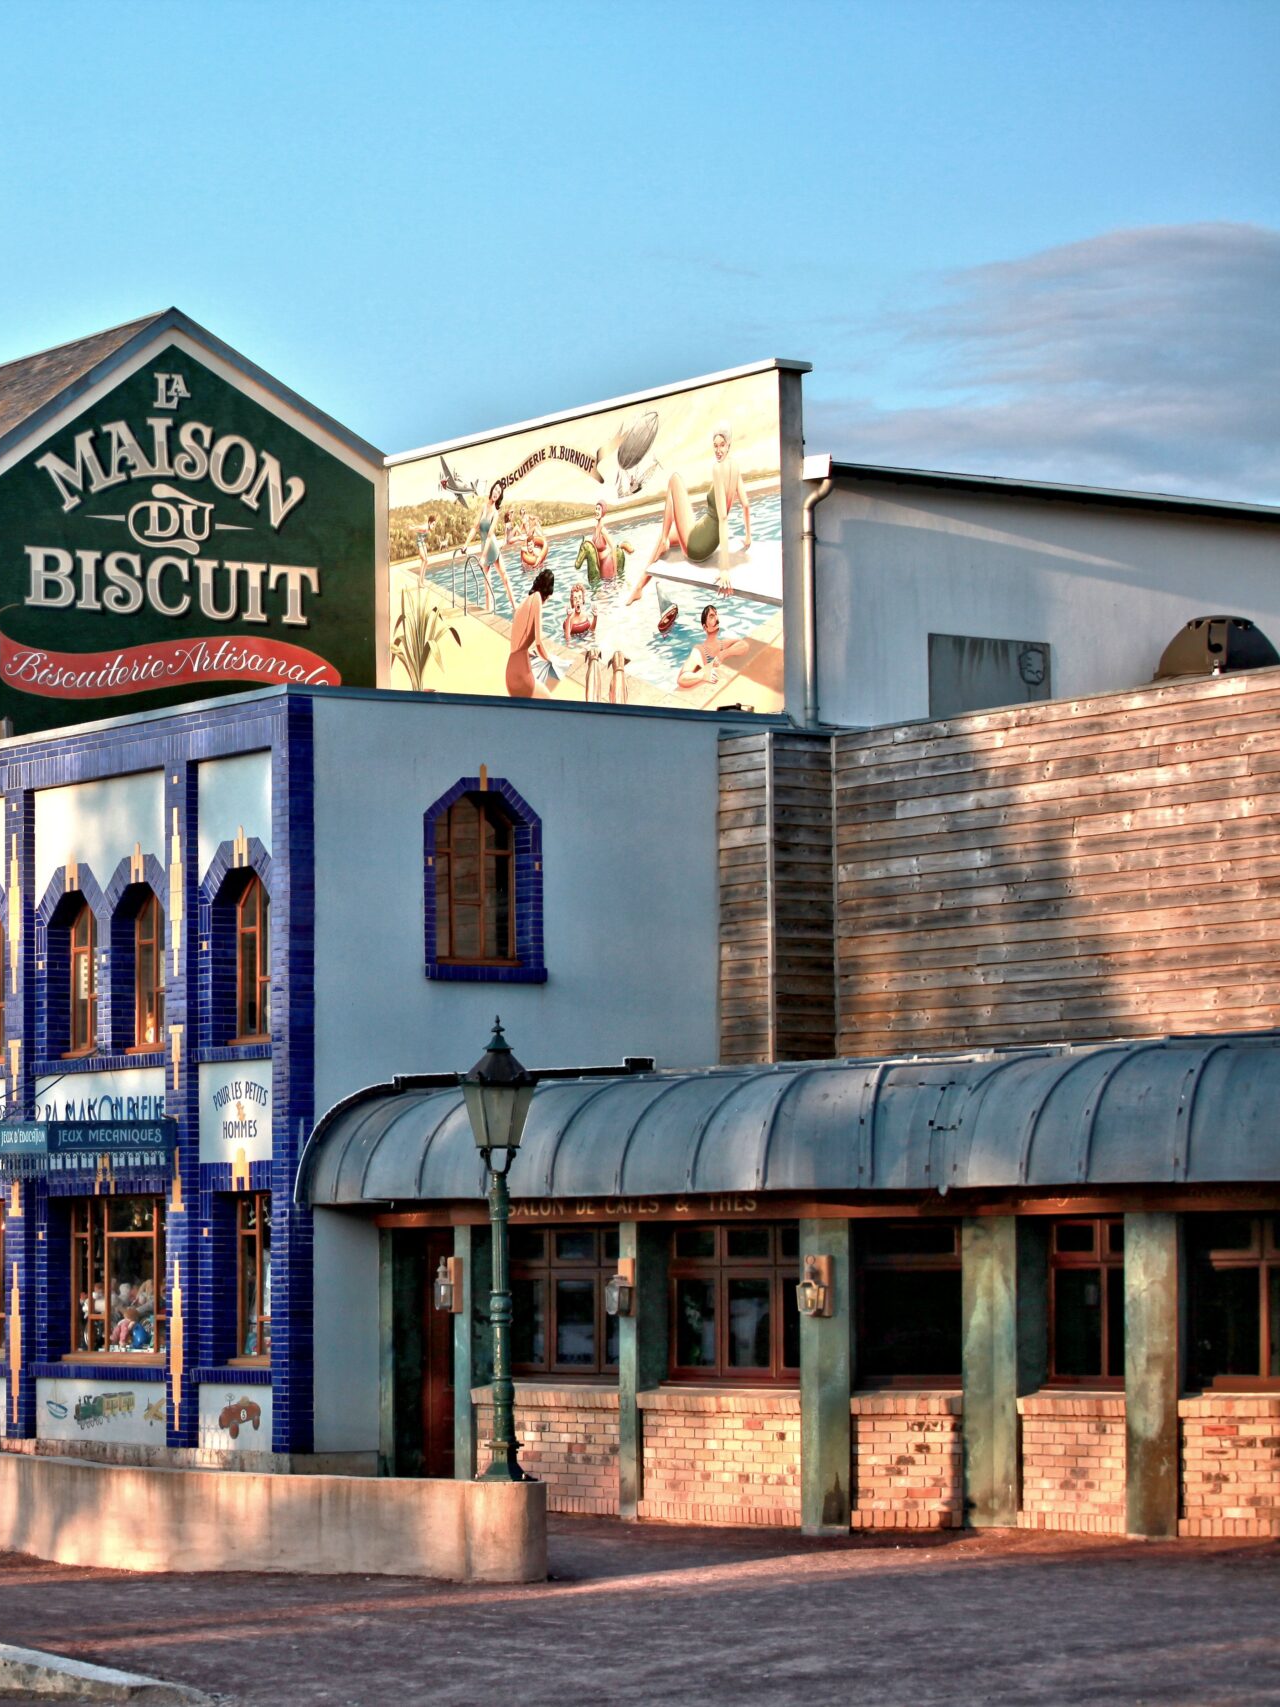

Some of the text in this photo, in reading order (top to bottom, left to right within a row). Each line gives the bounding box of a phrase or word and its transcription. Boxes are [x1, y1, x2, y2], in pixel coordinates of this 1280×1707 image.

[153, 372, 191, 410] LA
[34, 417, 306, 530] MAISON
[500, 448, 546, 489] BISCUITERIE
[560, 445, 595, 473] BURNOUF
[128, 483, 215, 555] DU
[24, 545, 320, 626] BISCUIT
[4, 651, 165, 689] Biscuiterie
[213, 1080, 268, 1111] POUR LES PETITS
[1, 1130, 14, 1146] JEUX
[58, 1128, 163, 1146] JEUX MECANIQUES
[222, 1120, 257, 1139] HOMMES
[507, 1198, 564, 1217] SALON
